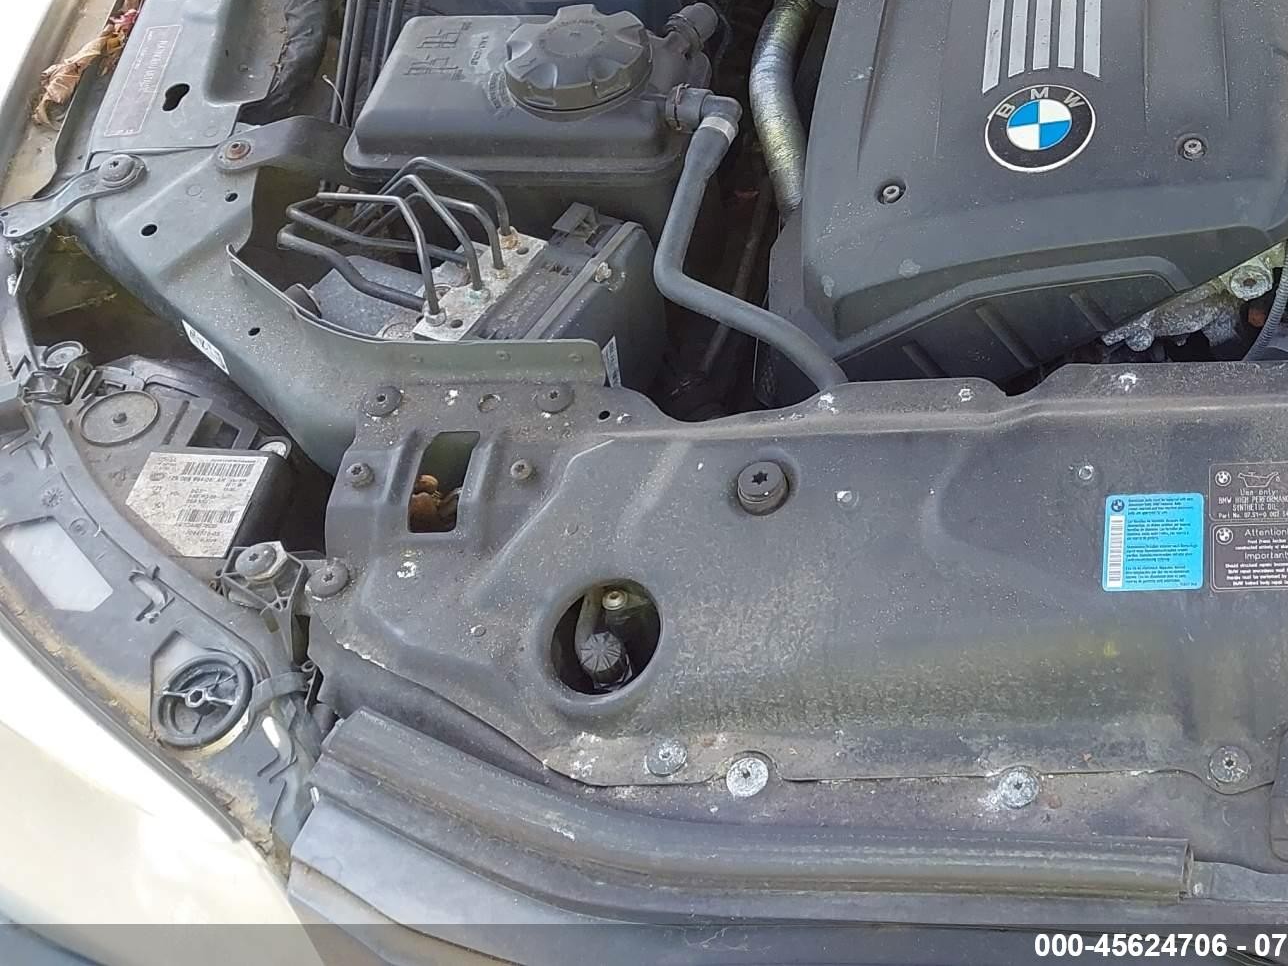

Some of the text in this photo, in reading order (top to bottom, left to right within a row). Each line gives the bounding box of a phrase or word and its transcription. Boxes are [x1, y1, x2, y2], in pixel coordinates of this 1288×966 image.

[996, 87, 1086, 119] BMW
[1218, 496, 1232, 505] BMW
[1235, 496, 1249, 504] HIGH
[1232, 503, 1278, 512] SYNTHETIC OIL
